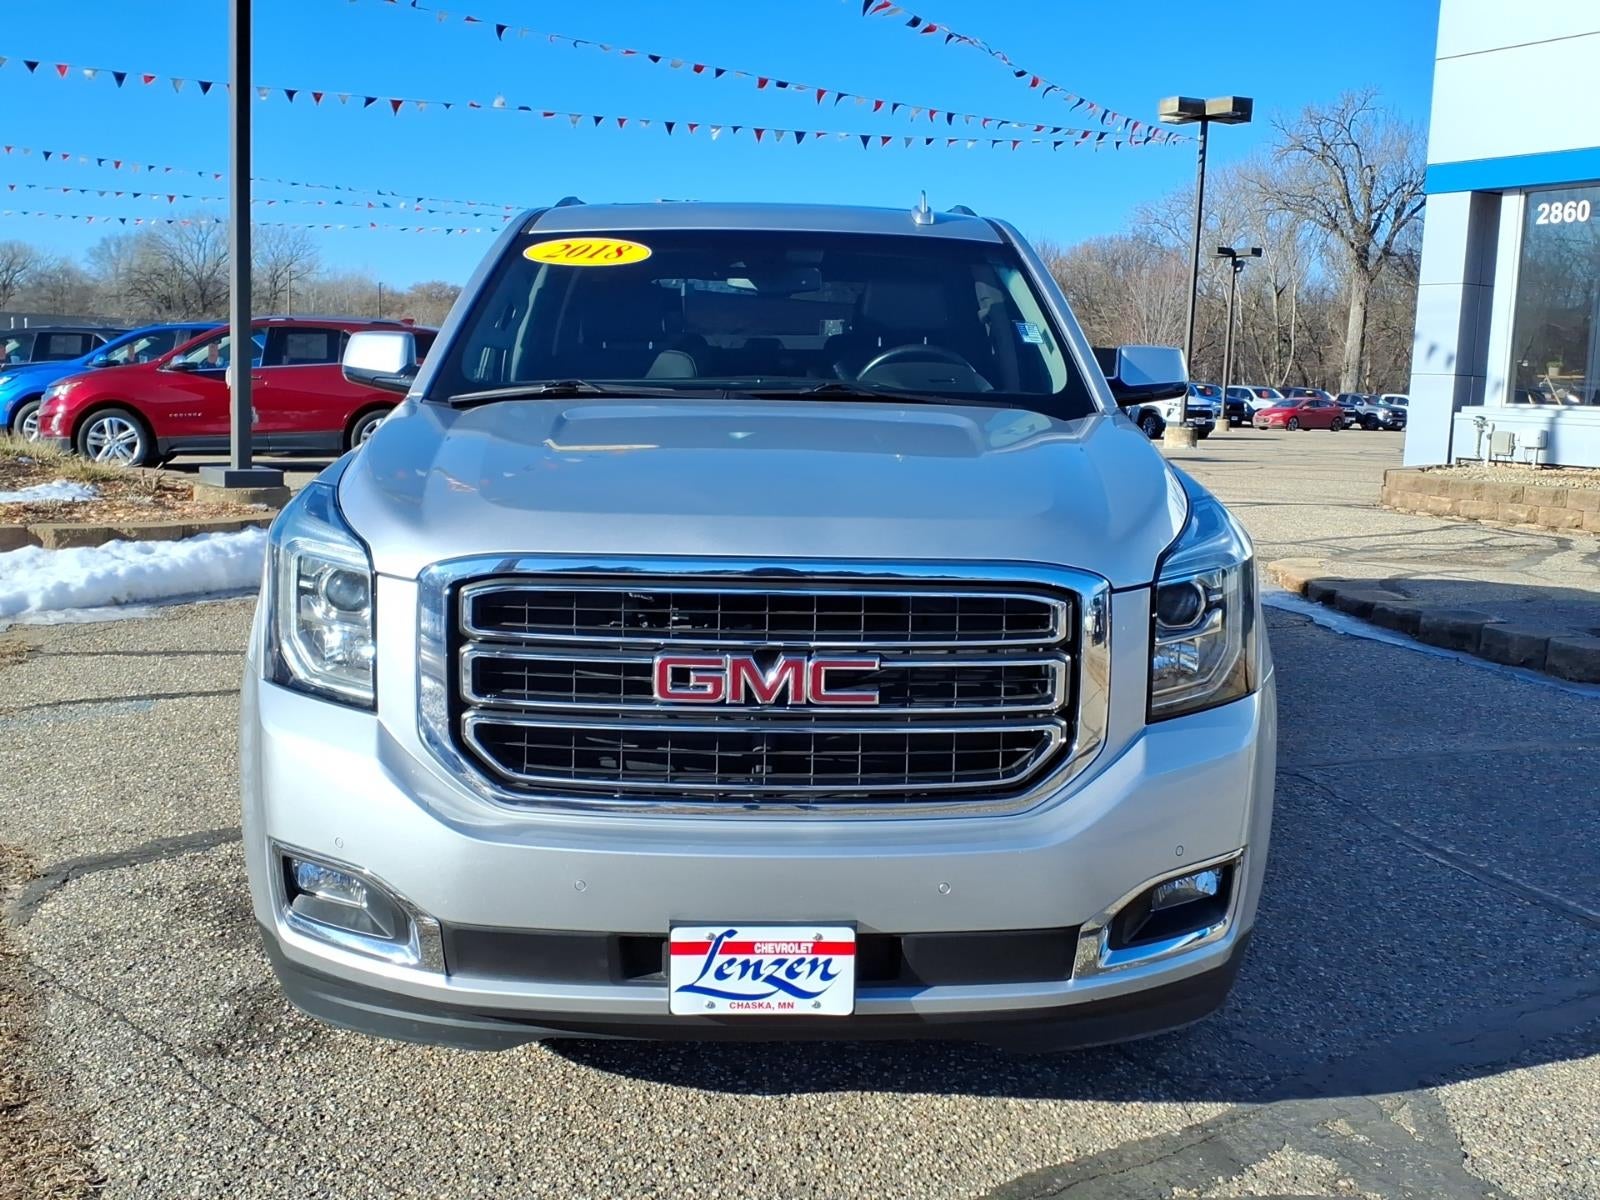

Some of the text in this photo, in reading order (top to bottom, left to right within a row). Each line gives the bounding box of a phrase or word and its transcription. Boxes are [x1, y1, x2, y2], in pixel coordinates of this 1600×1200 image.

[1535, 199, 1591, 225] 2860
[543, 243, 632, 260] 2018
[653, 652, 881, 705] GMC
[753, 942, 814, 955] CHEVROLET
[675, 928, 842, 1001] Lenzen
[729, 1001, 795, 1011] CHASKA, MN
